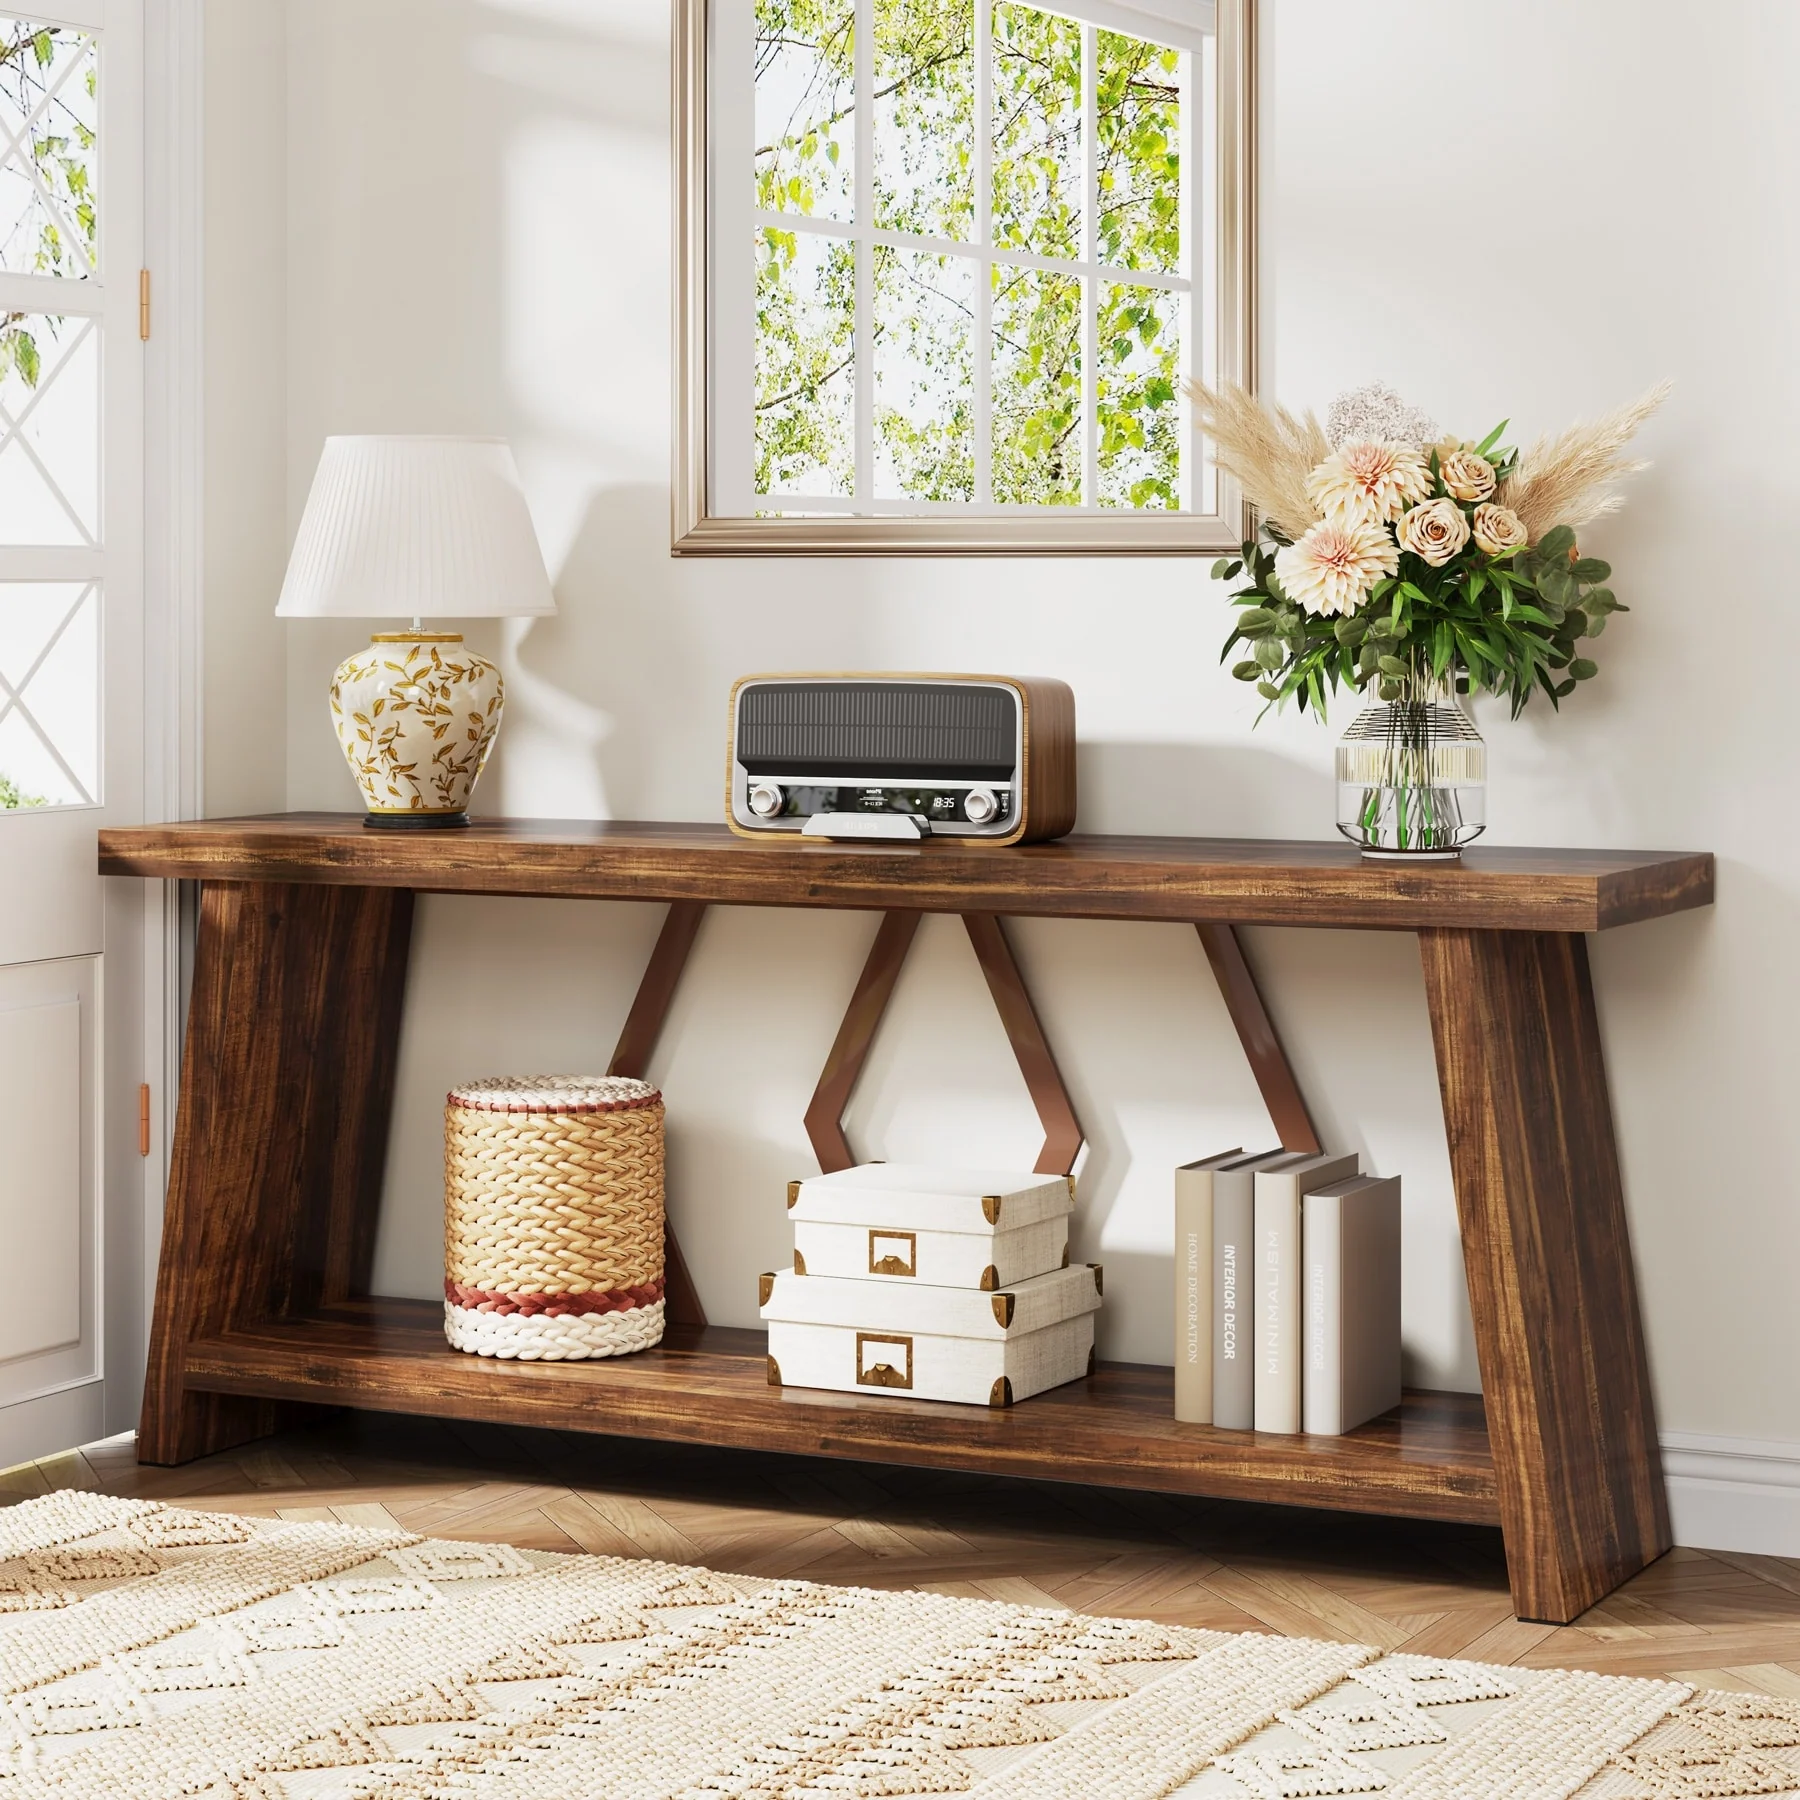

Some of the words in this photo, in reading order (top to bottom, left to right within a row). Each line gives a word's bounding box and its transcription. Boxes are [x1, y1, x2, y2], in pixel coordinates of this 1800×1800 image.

[933, 797, 955, 808] 18:35
[1187, 1232, 1199, 1274] HOME
[1224, 1244, 1237, 1310] INTERIOR
[1187, 1276, 1199, 1365] DECORATION
[1267, 1229, 1280, 1375] MINIMALISM
[1312, 1263, 1325, 1325] INTERIOR
[1224, 1313, 1237, 1361] DECOR
[1312, 1326, 1325, 1370] DECOR
